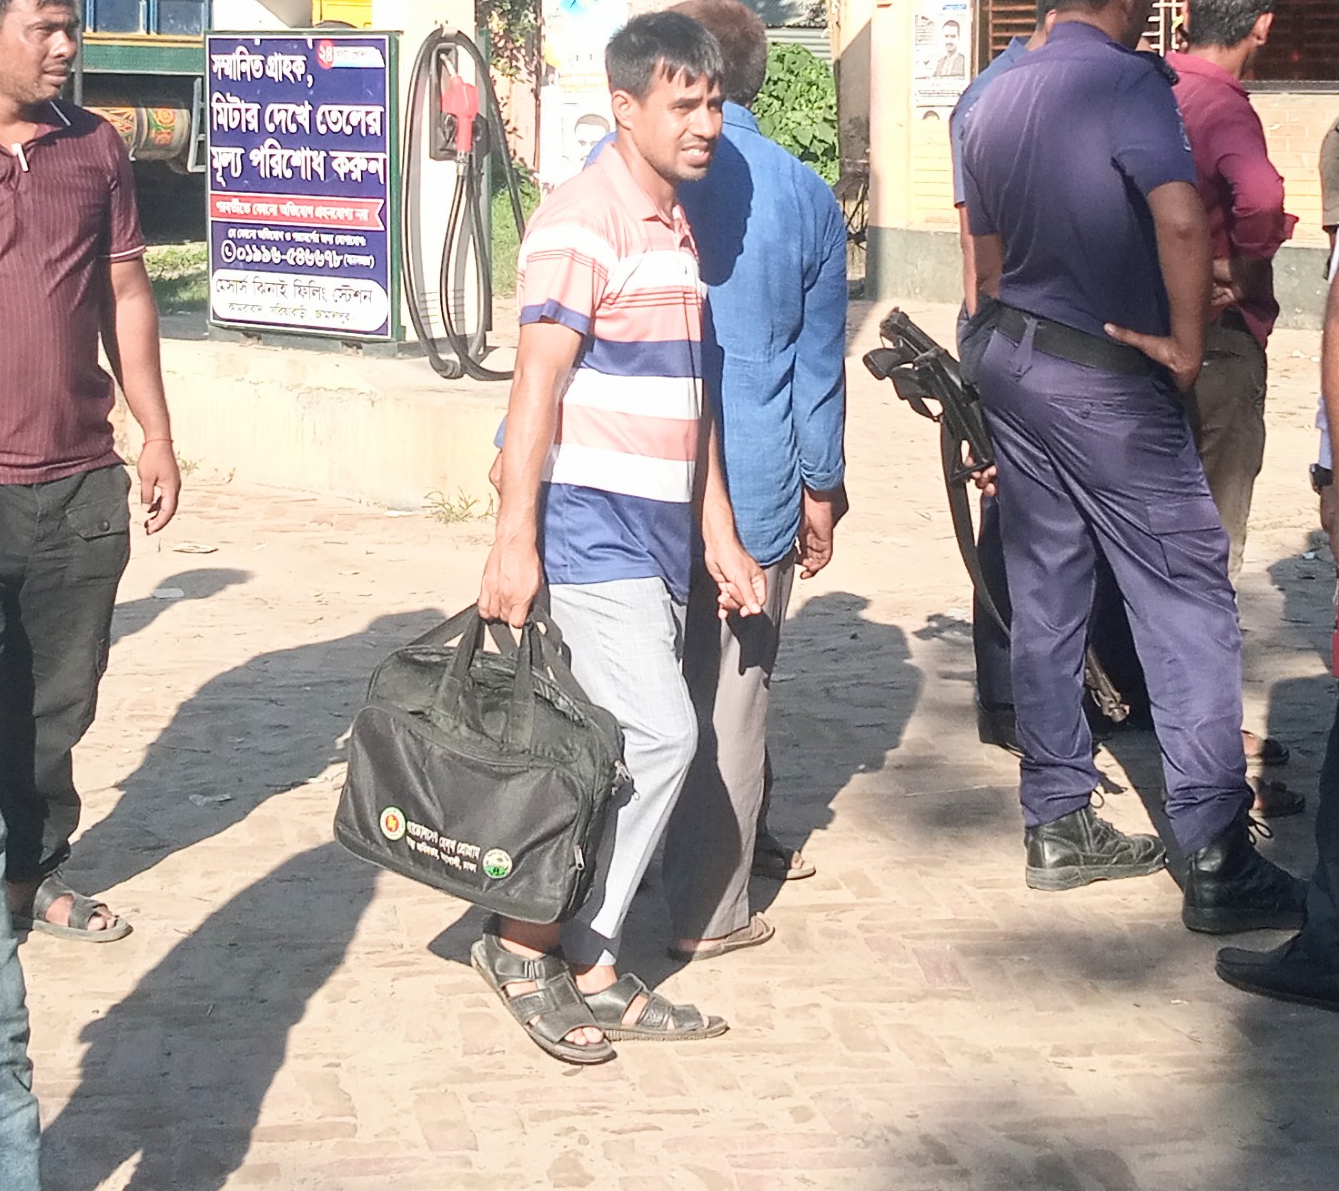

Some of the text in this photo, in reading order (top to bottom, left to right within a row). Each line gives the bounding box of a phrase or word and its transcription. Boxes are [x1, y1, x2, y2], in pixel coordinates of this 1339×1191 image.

[211, 46, 265, 82] সম্মানিত
[211, 92, 385, 138] মিটার দেখে তেলের
[211, 138, 387, 188] মূল্য পরিশোধ করুন
